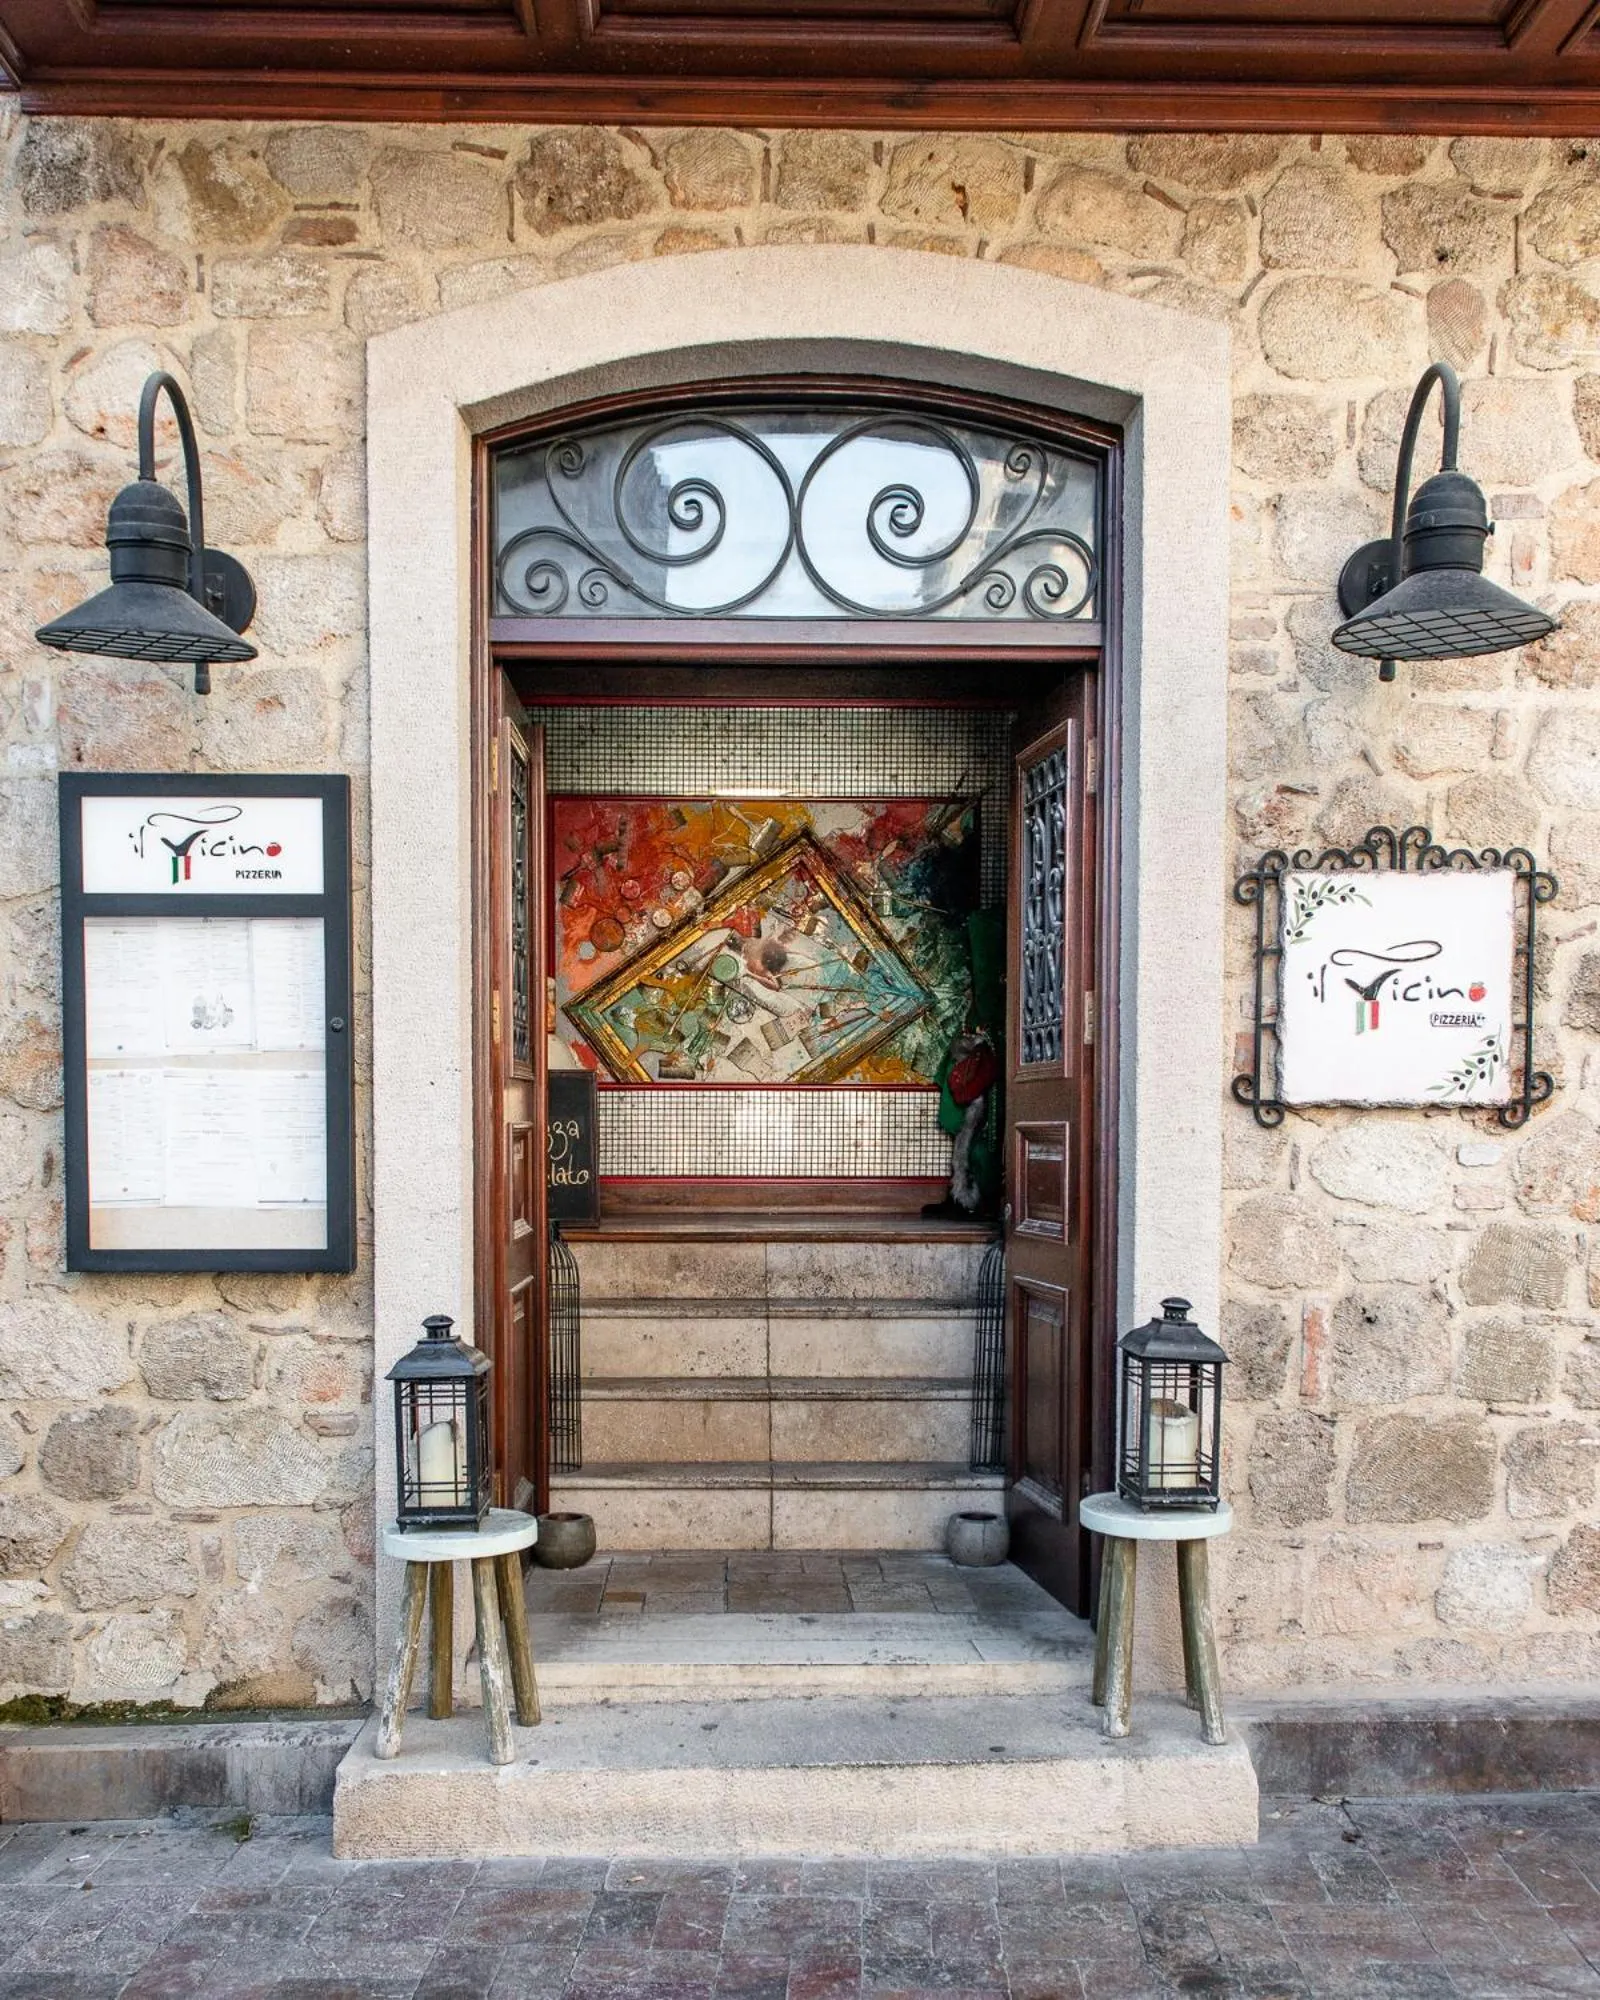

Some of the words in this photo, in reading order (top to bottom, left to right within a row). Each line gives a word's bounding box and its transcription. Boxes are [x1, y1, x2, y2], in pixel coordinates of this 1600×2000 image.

[235, 869, 282, 879] PIZZERIA
[1433, 1014, 1477, 1026] PIZZERIA
[547, 1153, 589, 1188] lato
